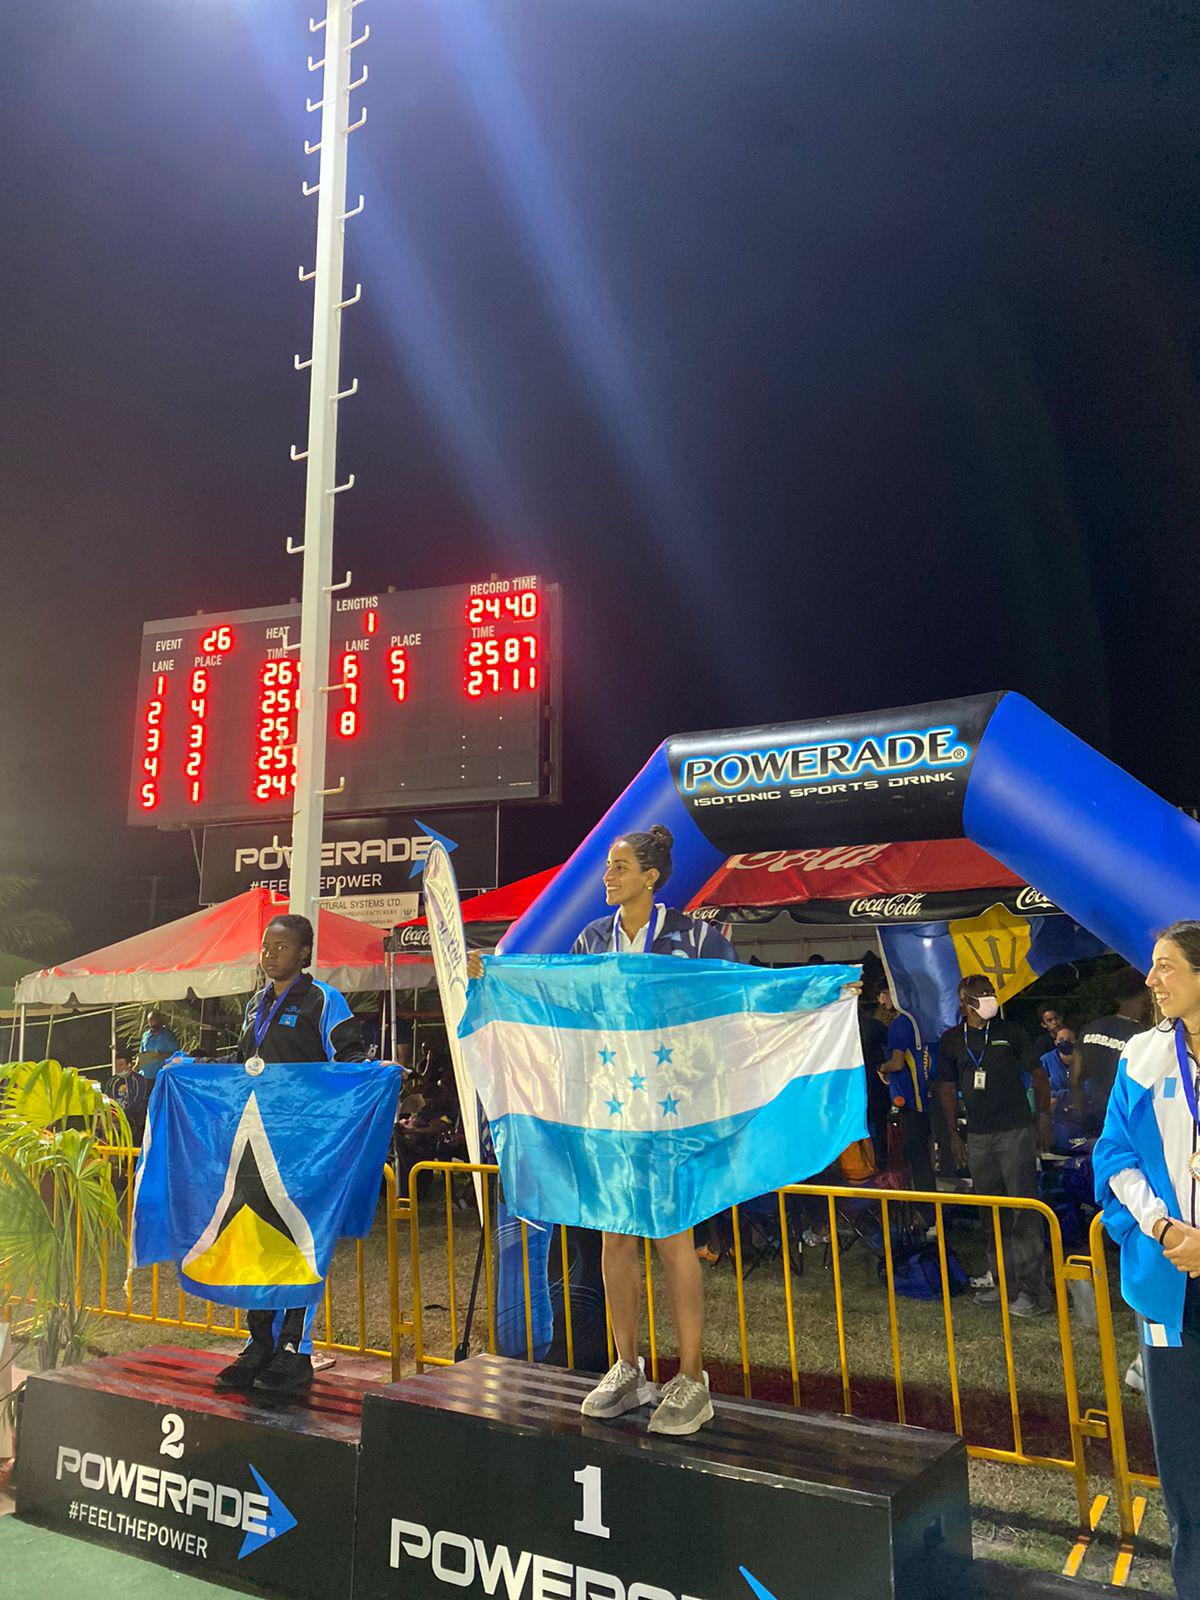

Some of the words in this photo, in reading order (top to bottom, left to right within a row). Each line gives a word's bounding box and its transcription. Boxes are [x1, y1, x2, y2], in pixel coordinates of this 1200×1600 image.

[470, 582, 510, 596] RECORD
[513, 577, 537, 591] TIME
[336, 596, 378, 612] LENGTHS
[266, 626, 290, 639] HEAT
[367, 611, 375, 633] 1
[471, 625, 495, 638] TIME
[155, 638, 183, 652] EVENT
[203, 627, 231, 651] 26
[345, 639, 370, 651] LANE
[391, 633, 422, 647] PLACE
[152, 659, 174, 672] LANE
[194, 655, 222, 667] PLACE
[267, 648, 288, 660] TIME
[391, 649, 405, 675] 5
[263, 661, 301, 686] 26
[343, 654, 358, 679] 6
[157, 676, 164, 696] 1
[192, 670, 207, 693] 6
[391, 678, 405, 701] 7
[261, 689, 301, 713] 25
[344, 682, 357, 705] 7
[148, 701, 161, 724] 2
[191, 699, 205, 718] 4
[259, 717, 290, 742] 25
[340, 711, 356, 736] 8
[147, 729, 159, 752] 3
[190, 725, 203, 748] 3
[144, 757, 157, 777] 4
[187, 752, 201, 775] 2
[257, 746, 299, 770] 25
[142, 784, 155, 807] 5
[193, 782, 200, 802] 1
[256, 773, 297, 799] 24
[693, 790, 782, 807] ISOTONIC
[789, 780, 879, 798] SPORTS
[888, 772, 956, 788] DRINK
[249, 873, 383, 892] #FEEEPOWER
[350, 900, 385, 909] SYSTEMS
[848, 893, 927, 918] Coca-Cola
[159, 1413, 185, 1459] 2
[573, 1464, 610, 1539] 1
[68, 1500, 208, 1559] #FEELTHEPOWER
